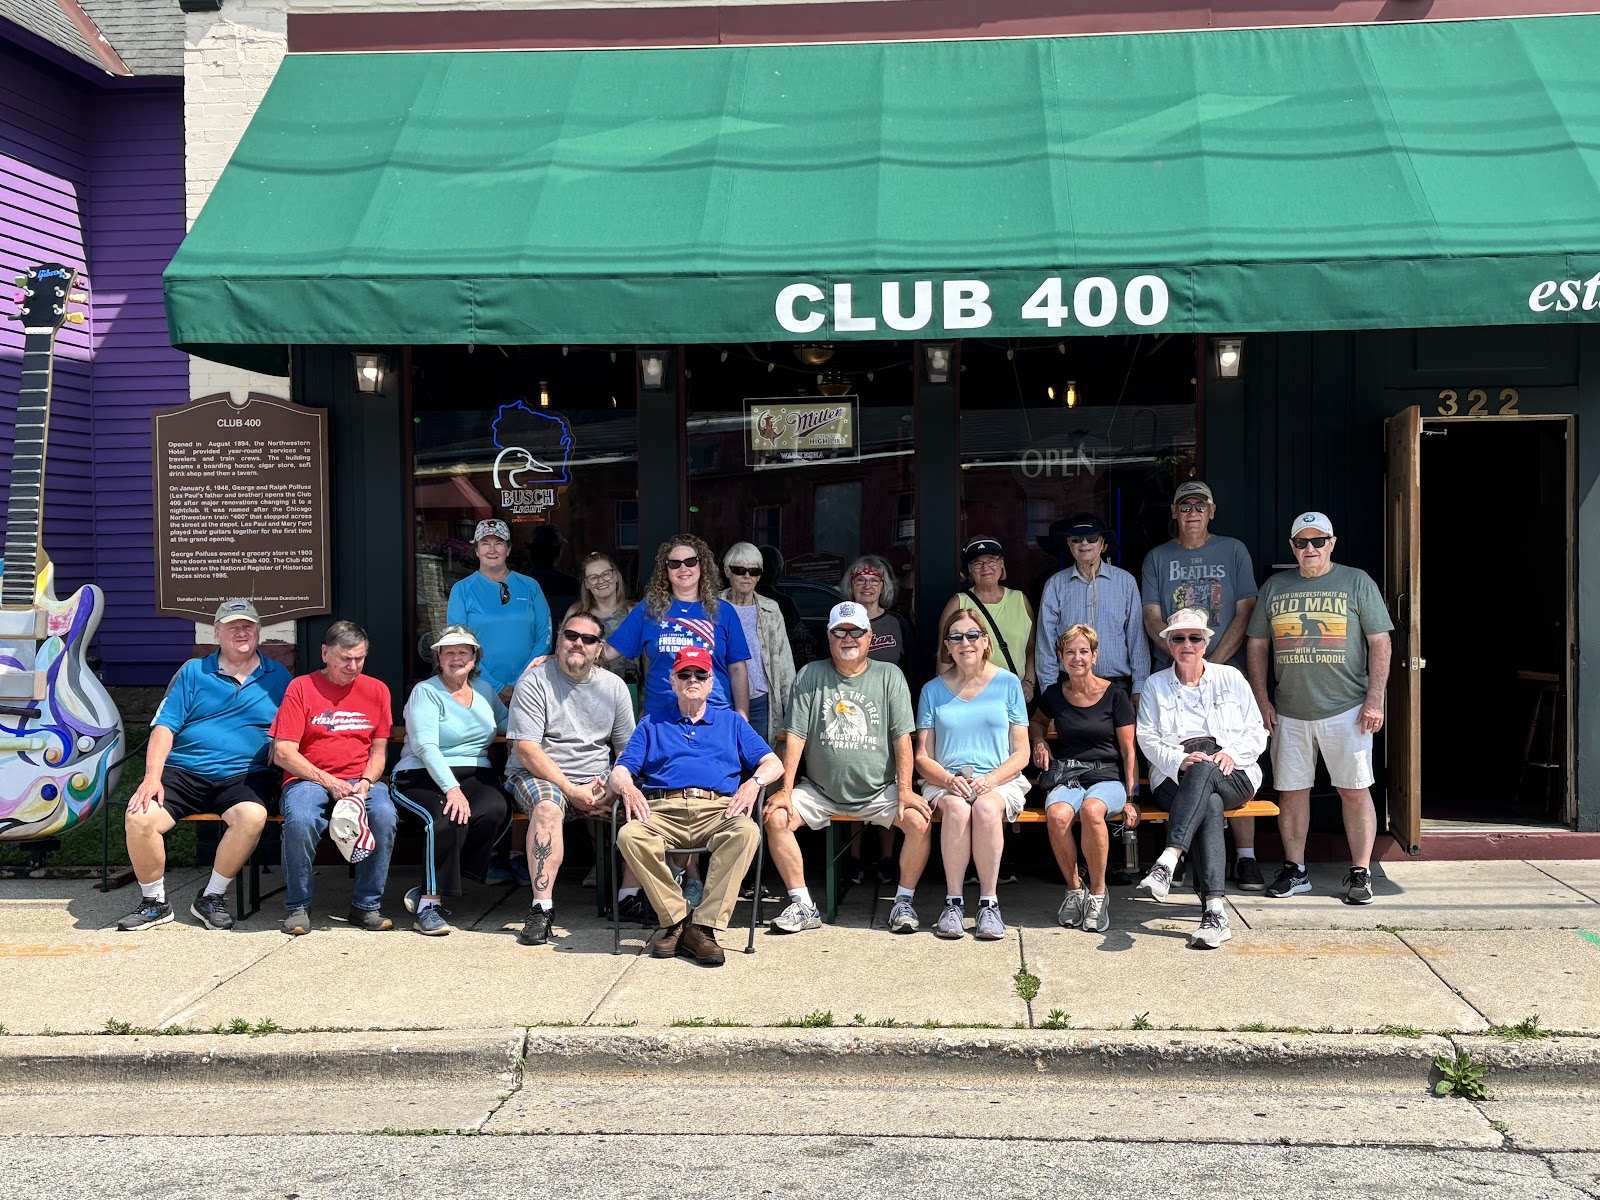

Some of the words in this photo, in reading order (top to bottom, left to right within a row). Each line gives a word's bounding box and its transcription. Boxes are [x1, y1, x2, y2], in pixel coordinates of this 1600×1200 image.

[1528, 272, 1600, 312] est
[774, 279, 993, 333] CLUB
[1021, 274, 1169, 328] 400
[1437, 388, 1519, 416] 322
[216, 419, 243, 427] CLUB
[244, 419, 261, 427] 400
[786, 407, 845, 435] Miller
[168, 441, 193, 449] Opened
[193, 448, 220, 456] provided
[278, 462, 296, 470] store,
[1020, 448, 1096, 478] OPEN
[269, 484, 287, 492] Ralph
[169, 492, 183, 500] (Les
[501, 489, 554, 507] BUSCH
[286, 506, 312, 514] Chicago
[233, 528, 259, 536] together
[189, 536, 208, 544] grand
[209, 536, 236, 544] opening.
[1169, 560, 1226, 581] BEATLES
[1272, 593, 1290, 602] NEVER
[1290, 591, 1338, 599] UNDERESTIMATE
[1271, 599, 1300, 617] OLD
[1305, 598, 1347, 615] MAN
[659, 637, 693, 646] FREEDOM
[1295, 646, 1310, 654] WITH
[1316, 654, 1346, 663] PADDLE
[821, 698, 833, 721] LAND
[834, 690, 845, 700] OF
[850, 690, 866, 703] THE
[864, 701, 880, 725] FREE
[865, 736, 877, 744] THE
[834, 741, 859, 749] BRAVE
